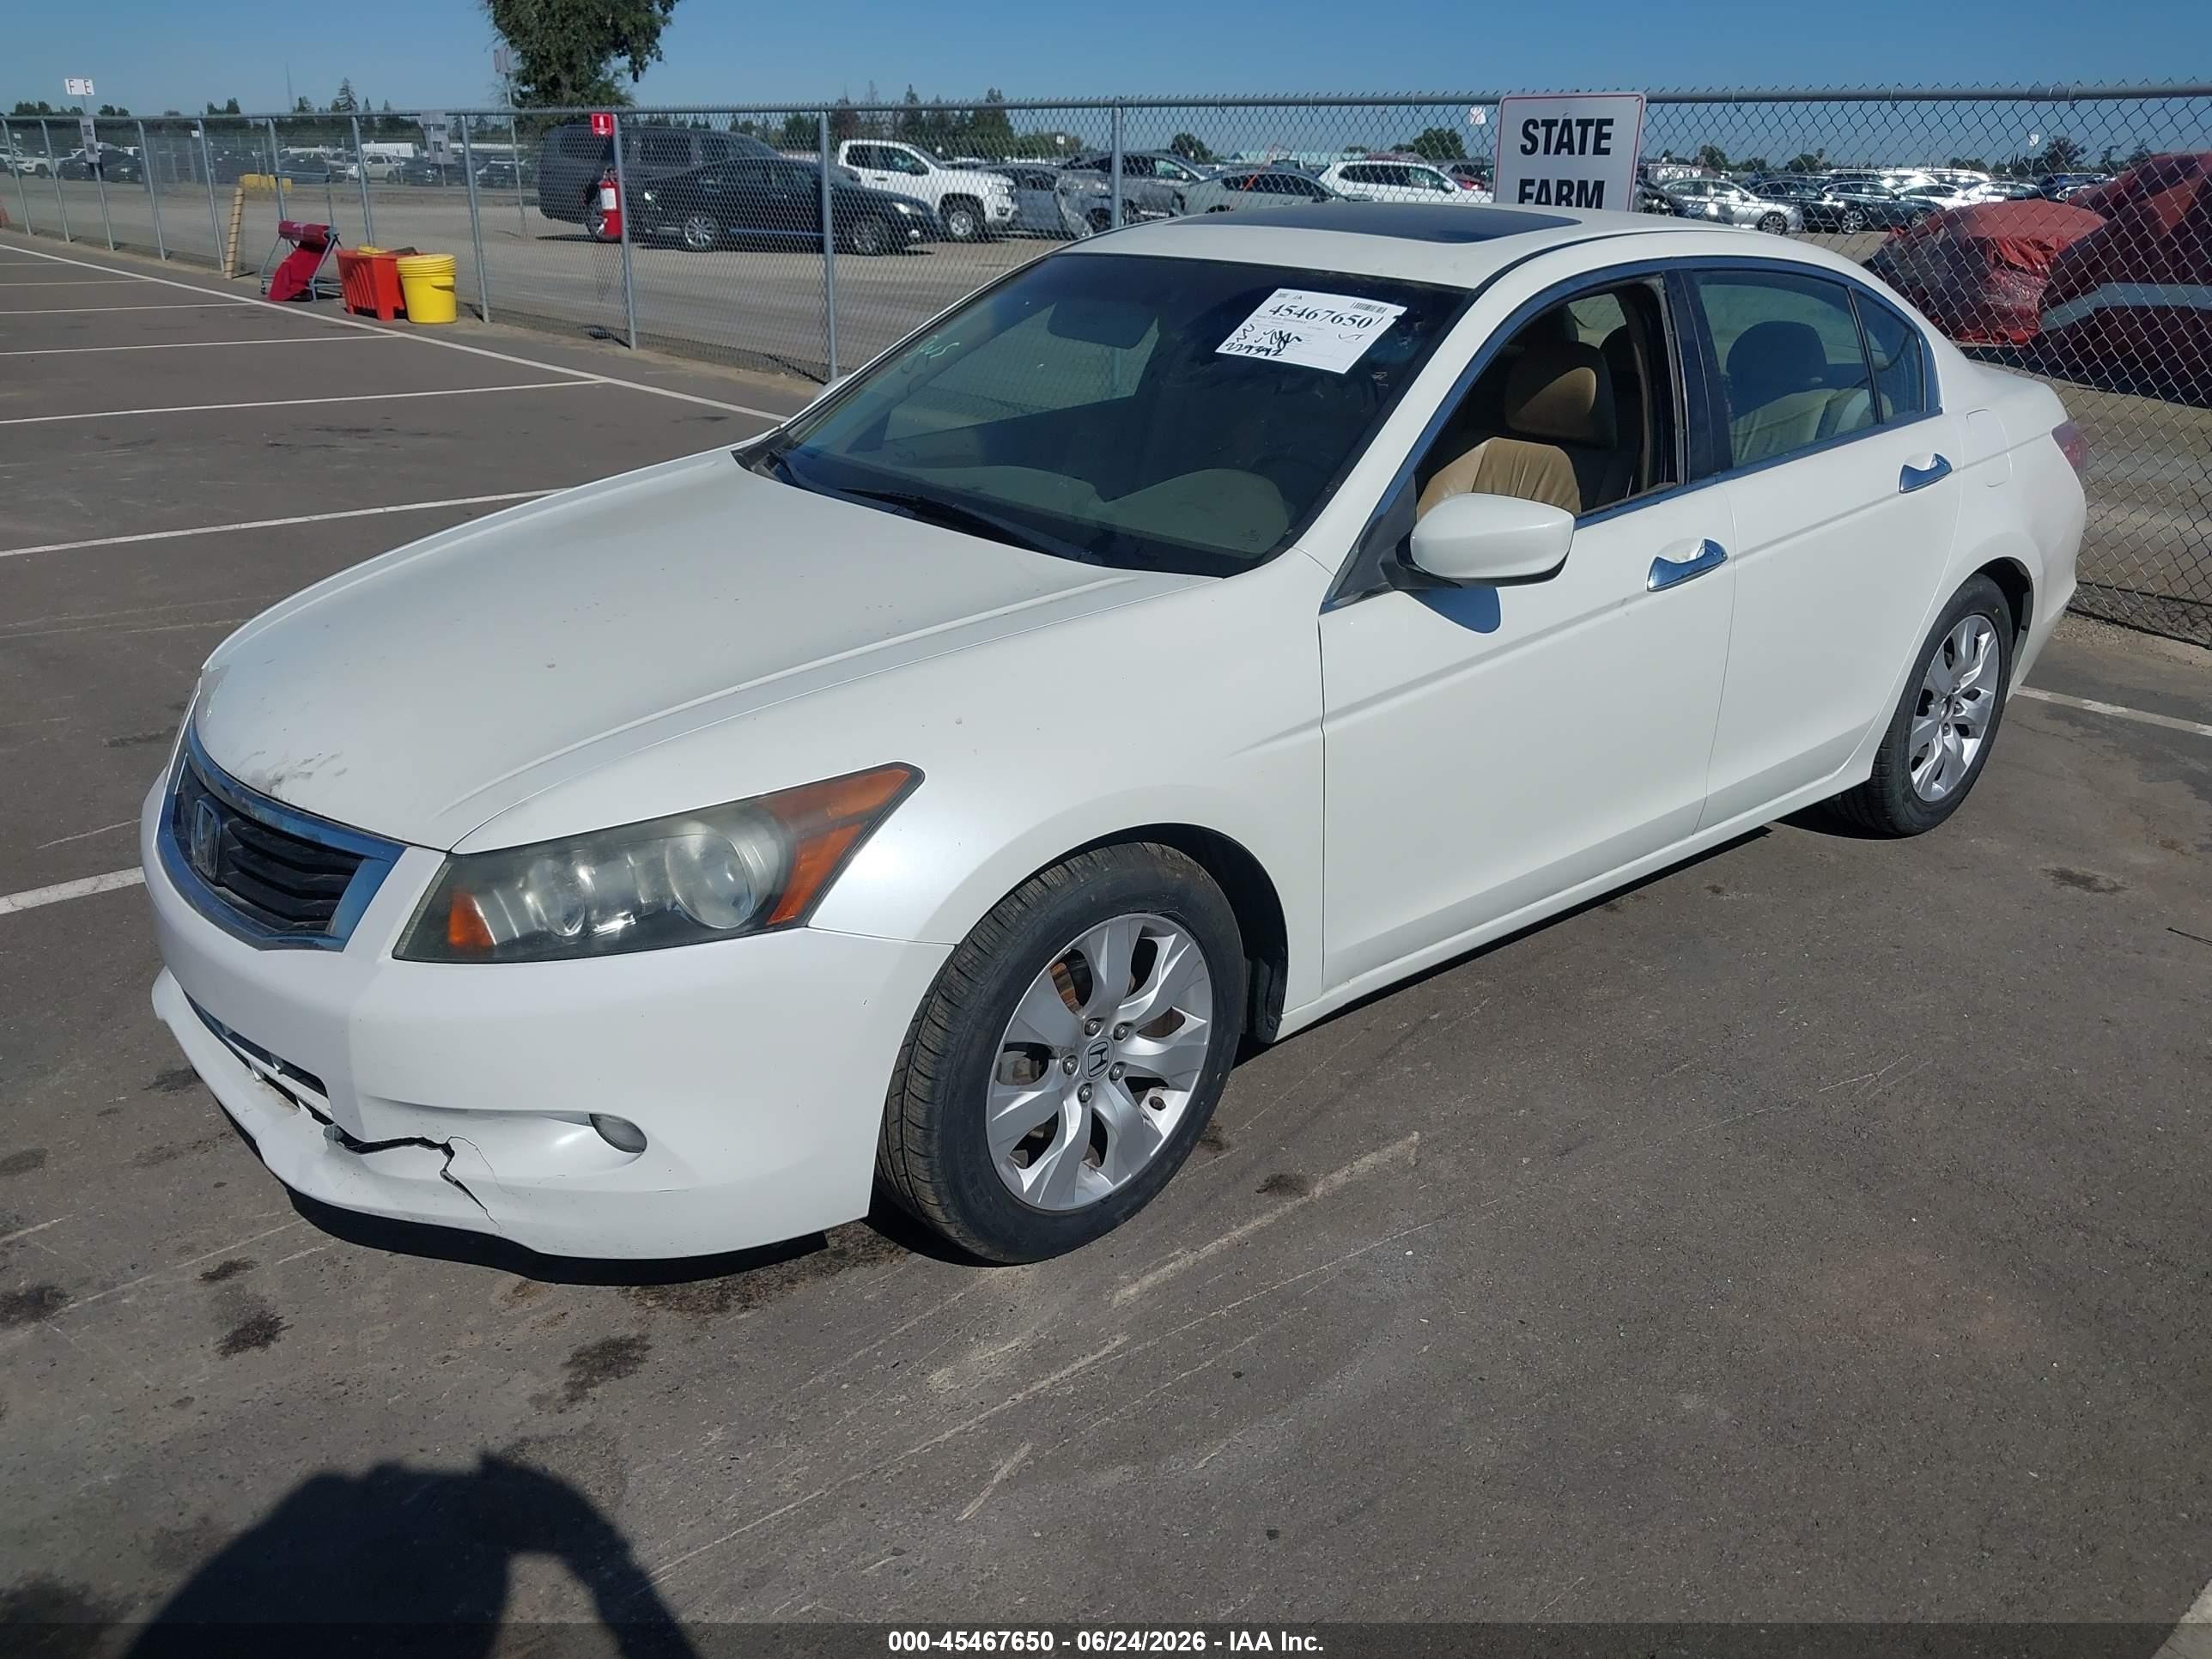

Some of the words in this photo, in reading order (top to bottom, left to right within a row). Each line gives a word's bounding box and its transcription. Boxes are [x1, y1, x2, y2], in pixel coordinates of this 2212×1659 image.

[1520, 118, 1614, 155] STATE
[1518, 179, 1605, 210] FARM
[1269, 303, 1374, 329] 45467650
